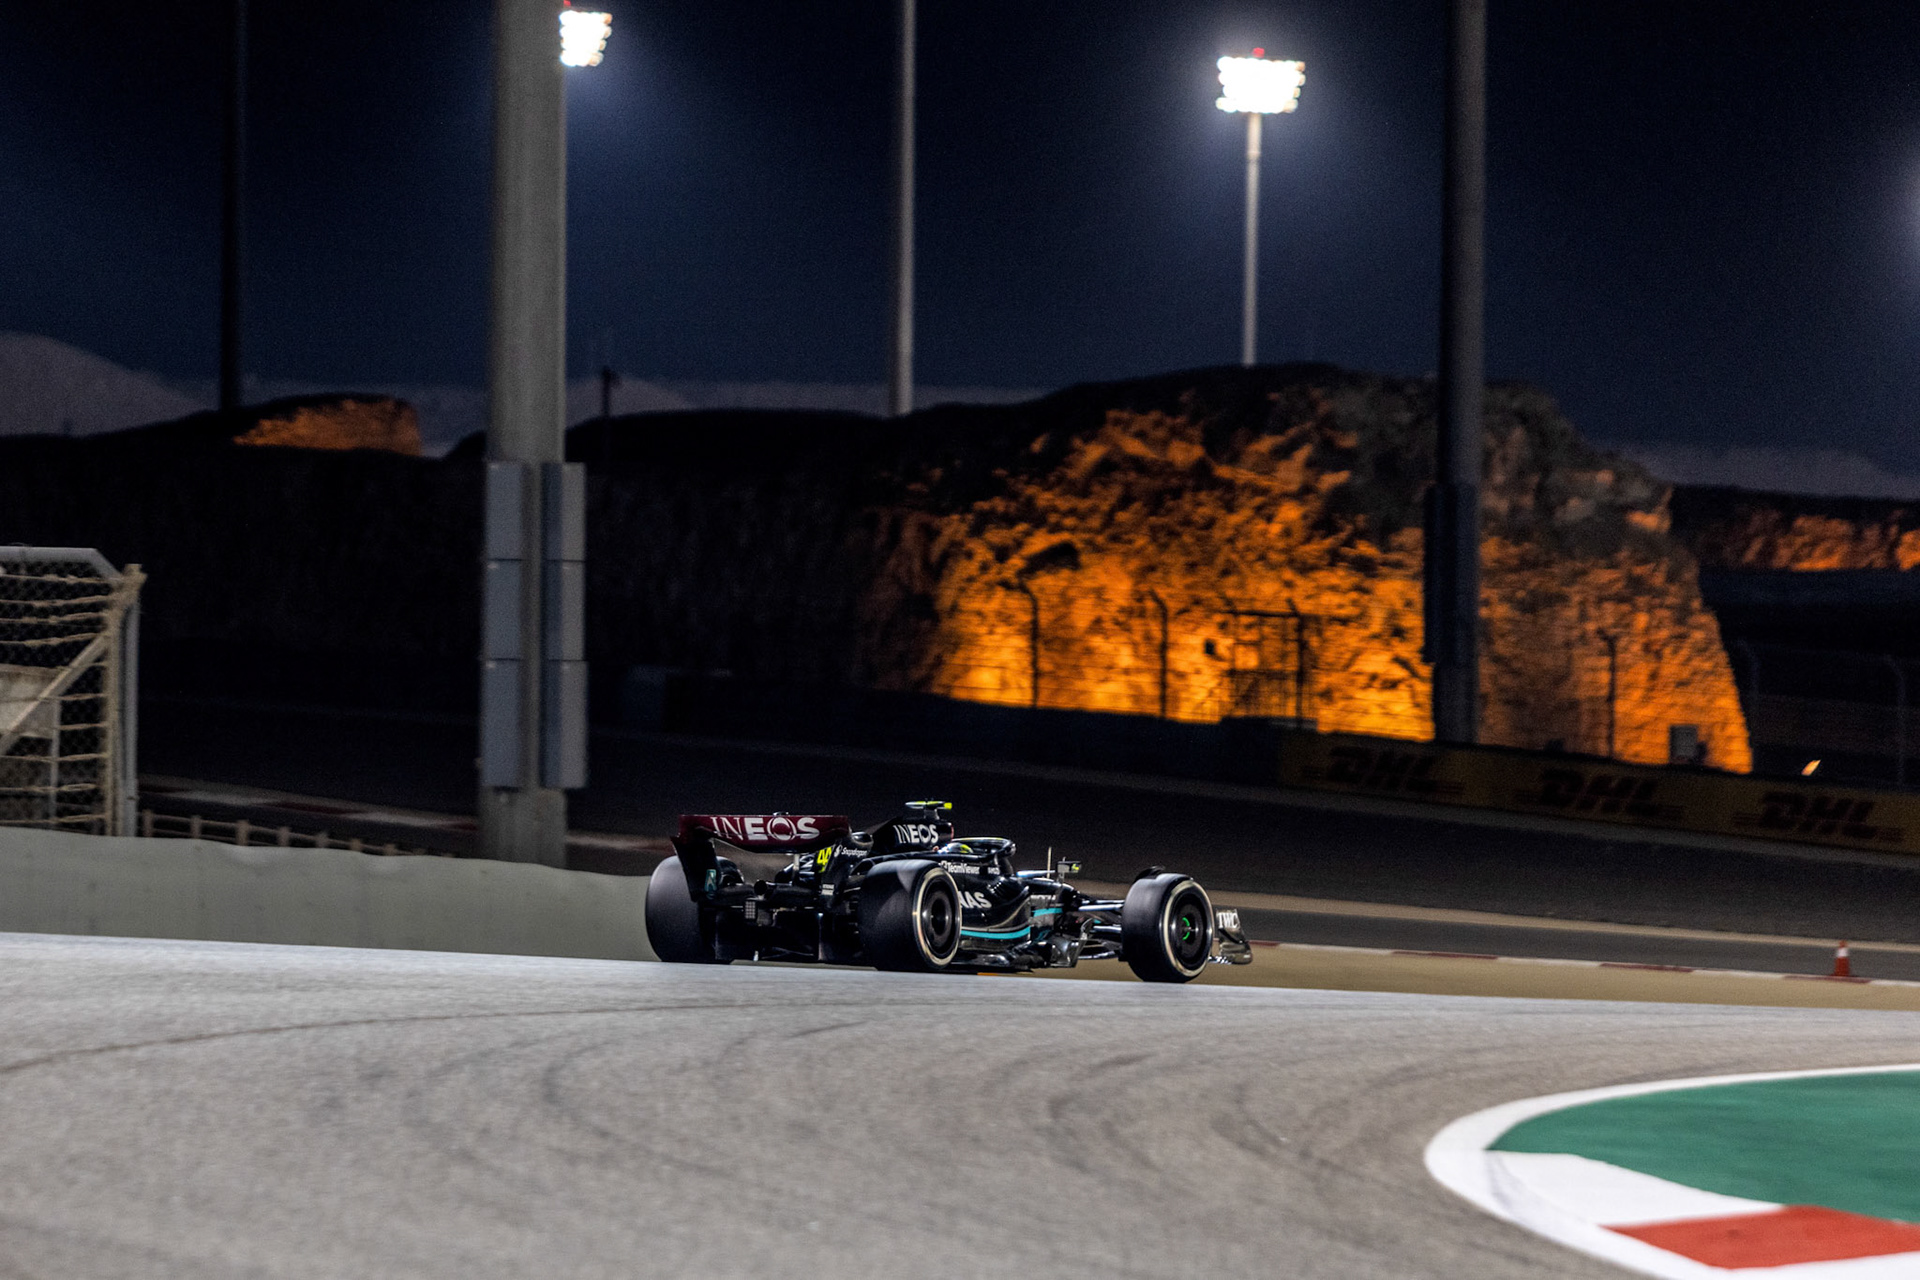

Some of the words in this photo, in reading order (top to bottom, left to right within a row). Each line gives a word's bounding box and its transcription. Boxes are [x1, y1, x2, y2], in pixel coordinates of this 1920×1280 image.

[1328, 746, 1435, 793] DHL
[1541, 768, 1660, 818] DHL
[710, 816, 820, 841] INEOS
[892, 824, 939, 844] INEOS
[1761, 792, 1878, 840] DHL
